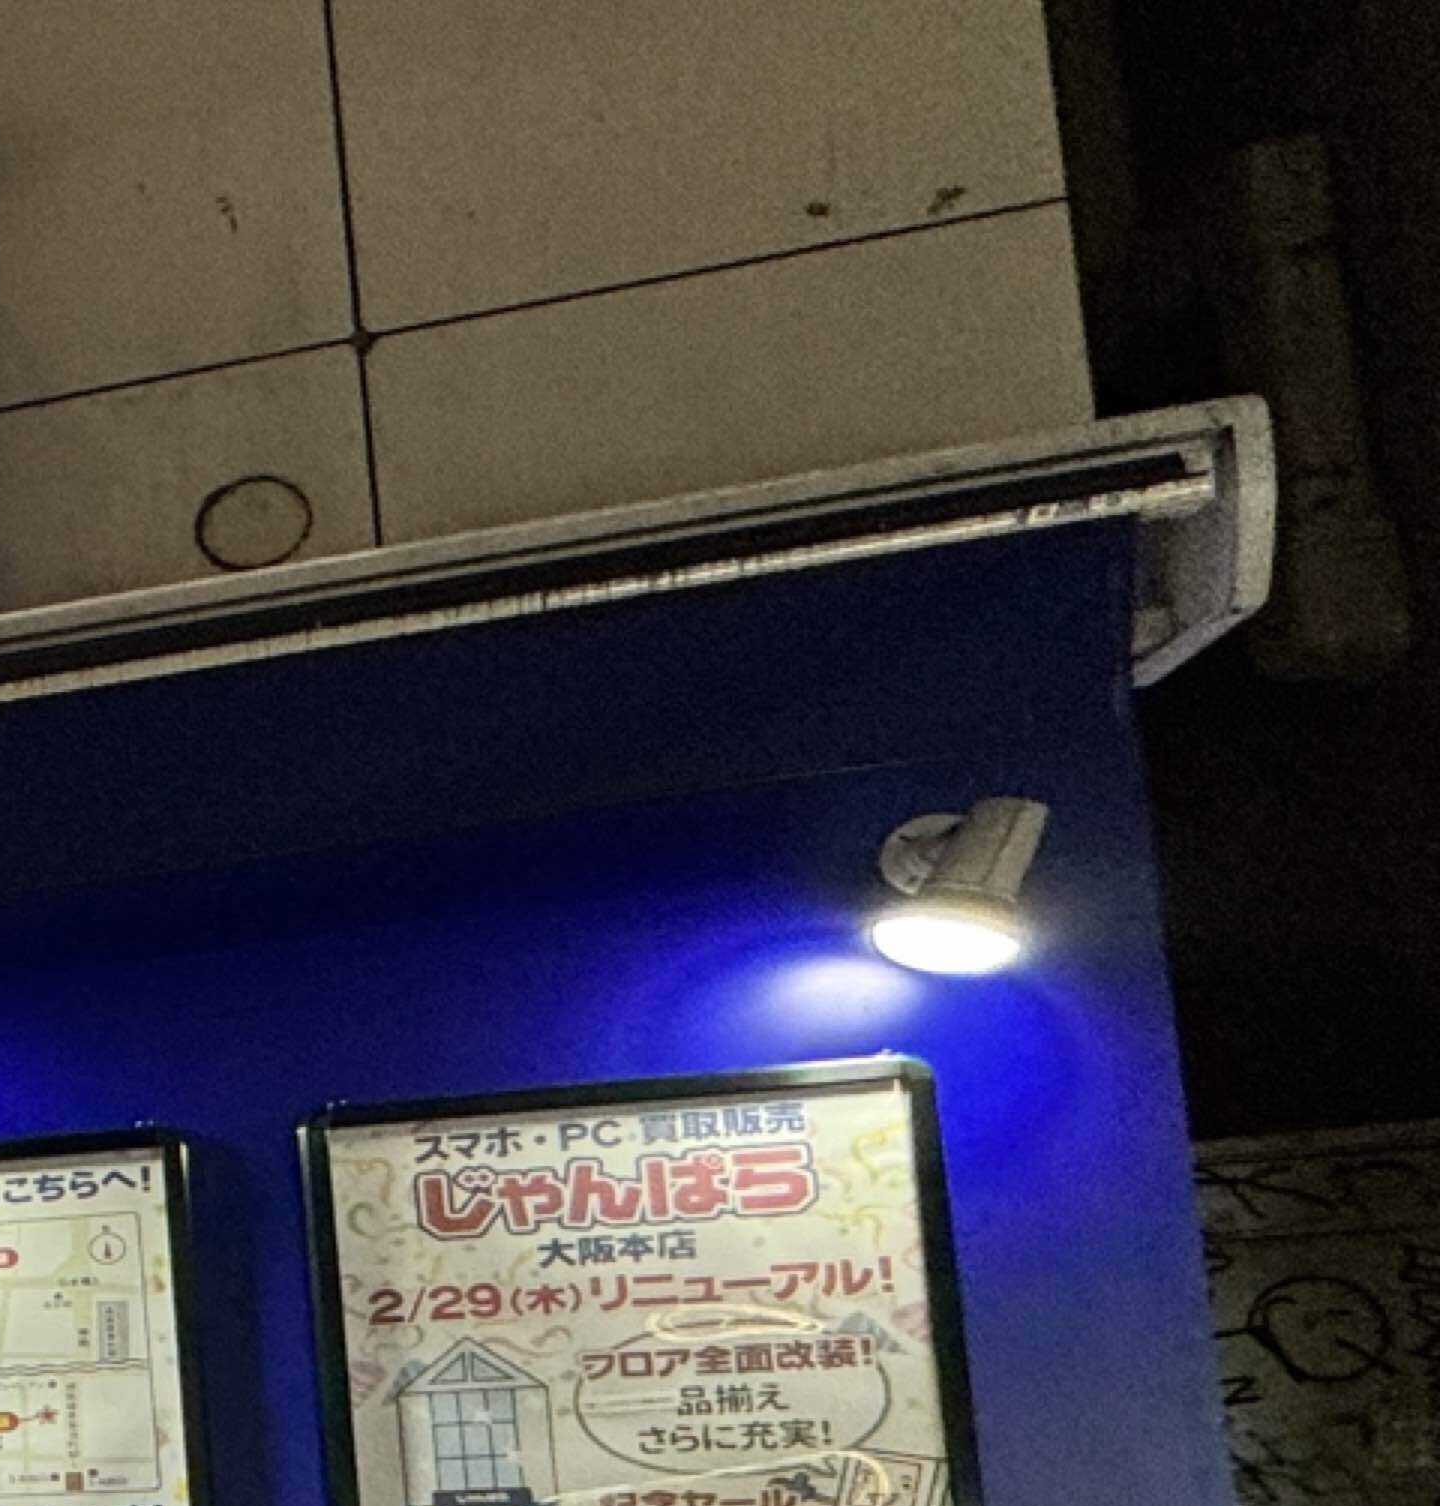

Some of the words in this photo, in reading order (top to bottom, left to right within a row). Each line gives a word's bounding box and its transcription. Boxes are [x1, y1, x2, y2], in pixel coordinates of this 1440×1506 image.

[413, 1118, 624, 1162] スマホ・PC
[641, 1101, 806, 1146] 買取販売
[417, 1144, 819, 1237] じゃんぱら
[537, 1229, 697, 1269] 大阪本店
[368, 1283, 581, 1325] 2/29(木)
[590, 1256, 897, 1310] リニューアル!
[584, 1342, 874, 1378] フロア全面改装!
[676, 1386, 789, 1417] 品揃え
[637, 1417, 833, 1453] さらに充実!
